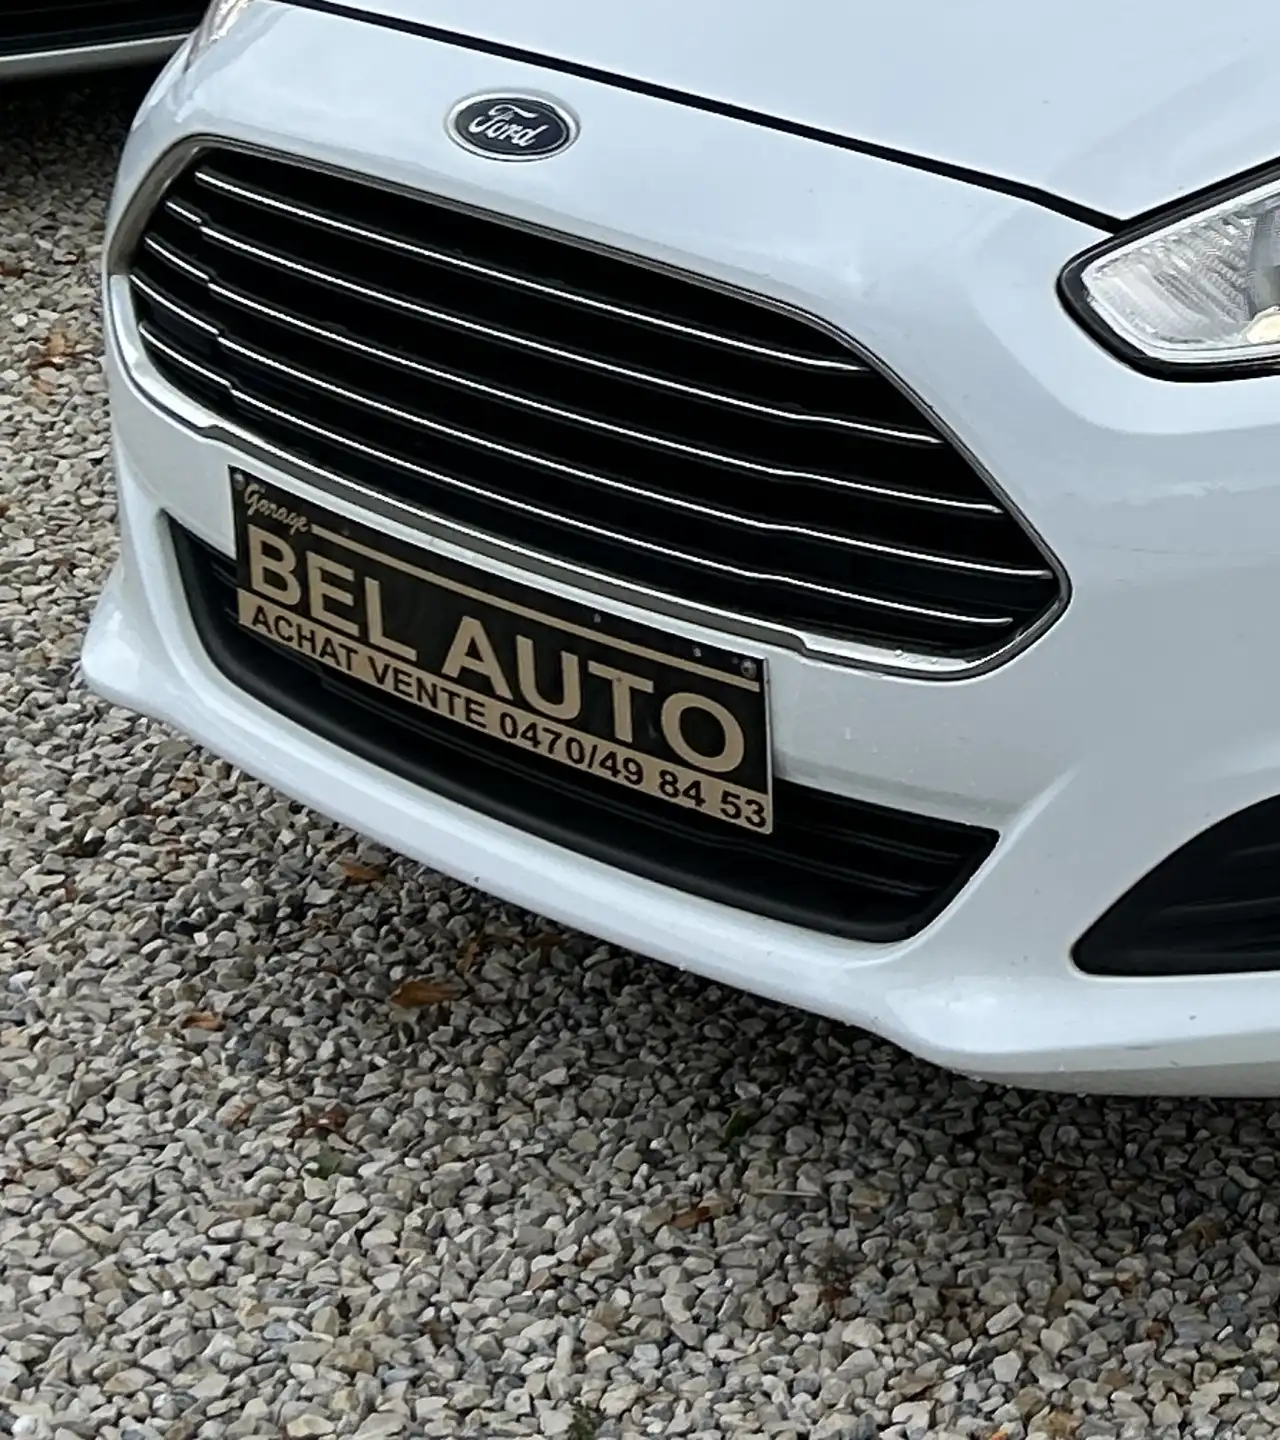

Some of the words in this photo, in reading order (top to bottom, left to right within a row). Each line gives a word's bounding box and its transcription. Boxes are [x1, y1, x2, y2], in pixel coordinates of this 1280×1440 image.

[468, 104, 550, 147] Ford
[244, 482, 310, 535] Garage
[247, 523, 418, 662] BEL
[440, 615, 746, 774] AUTO
[252, 604, 359, 673] ACHAT
[367, 654, 487, 727] VENTE
[499, 711, 644, 786] 0470/49
[658, 762, 706, 809] 84
[720, 788, 767, 829] 53
